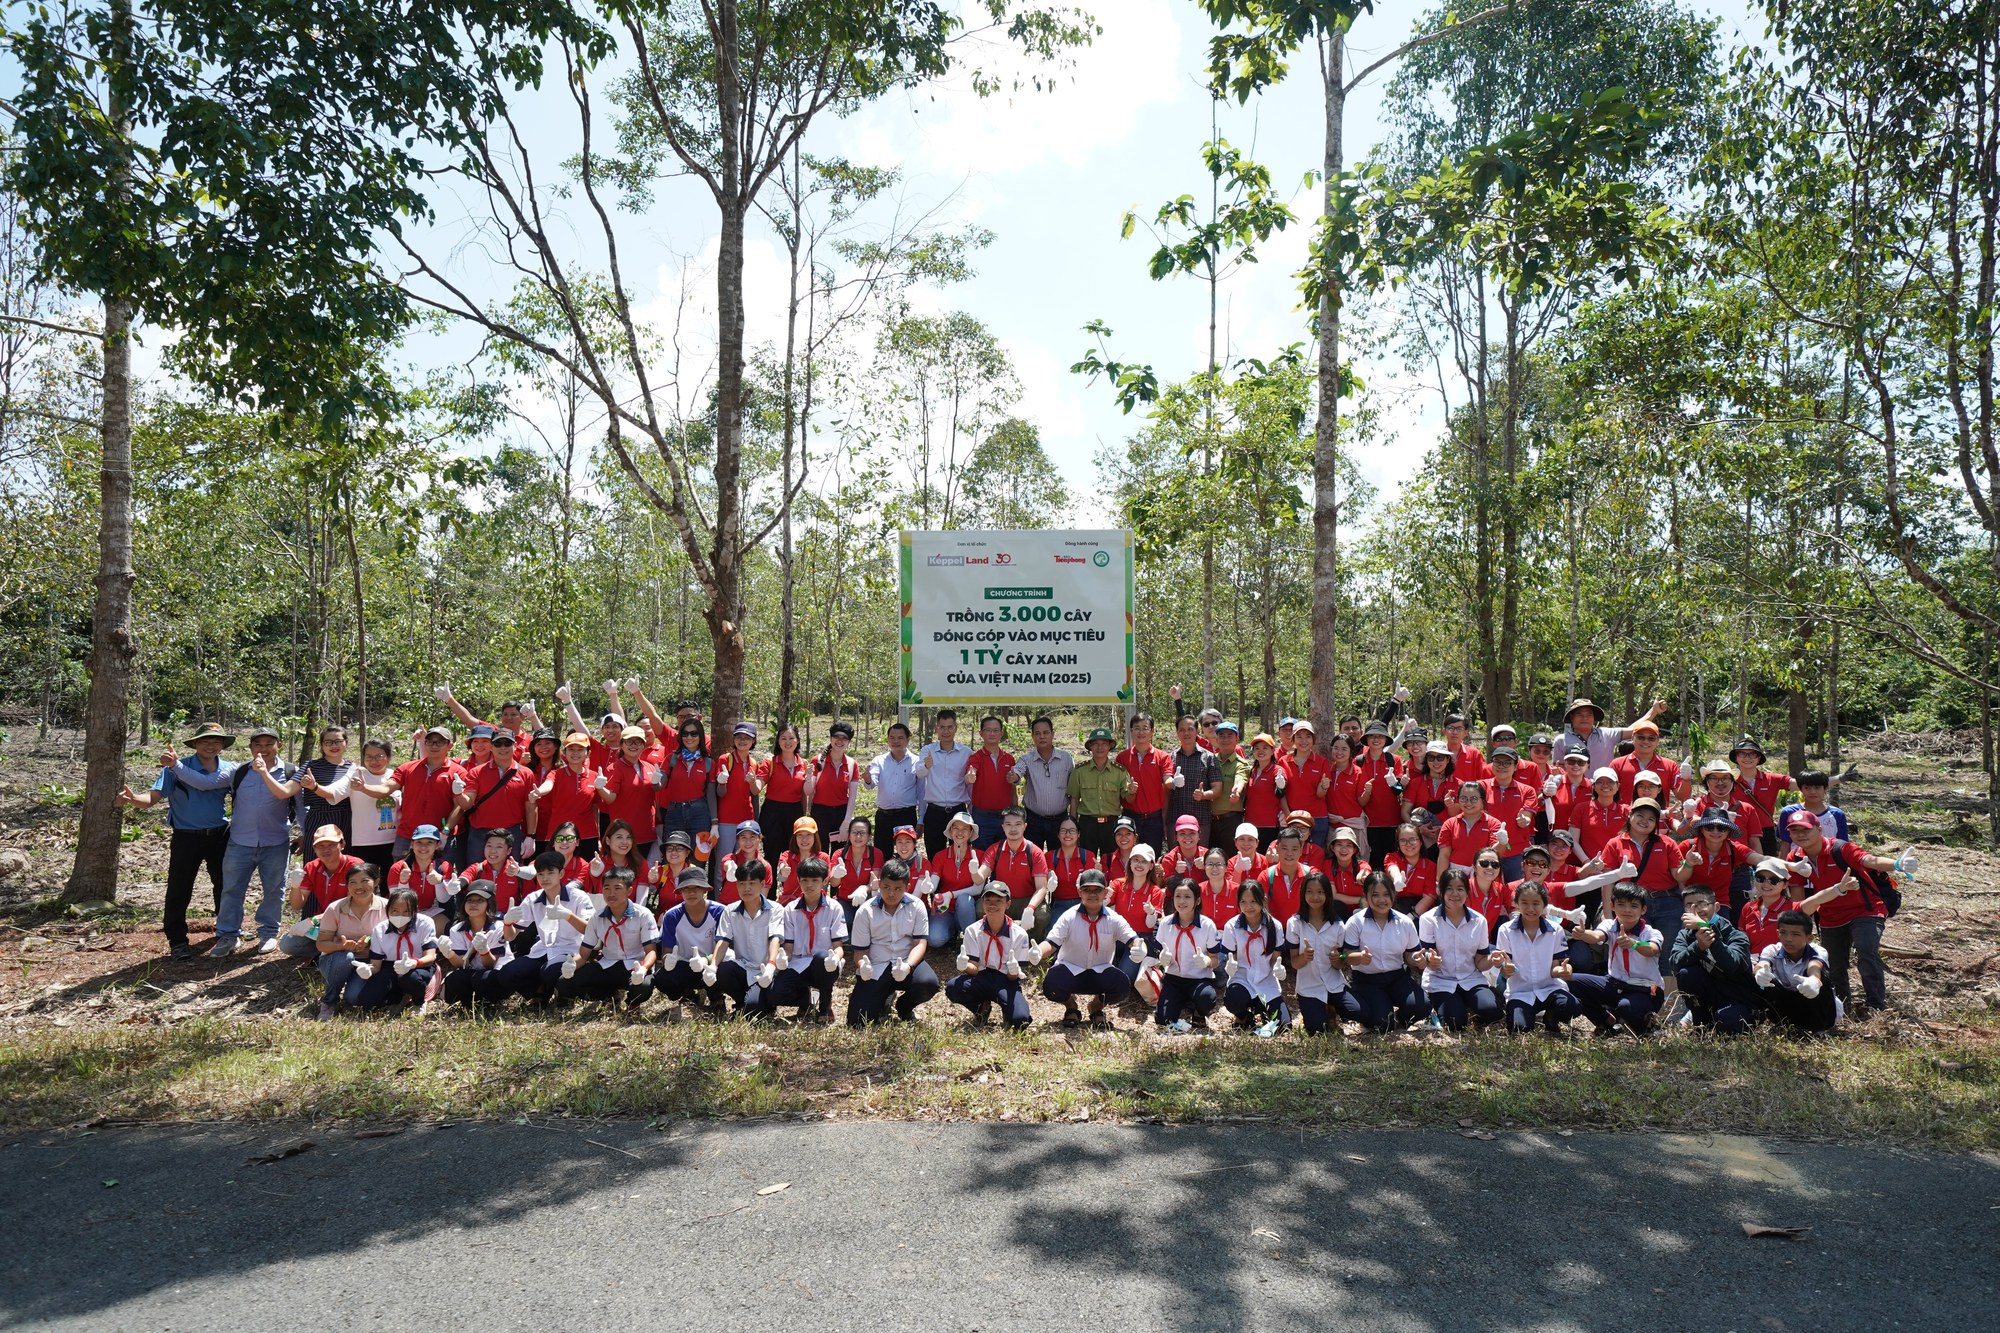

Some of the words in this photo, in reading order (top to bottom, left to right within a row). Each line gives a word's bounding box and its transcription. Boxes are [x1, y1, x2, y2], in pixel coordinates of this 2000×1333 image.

[996, 554, 1011, 564] 30
[946, 608, 994, 622] TRỒNG
[998, 606, 1062, 622] 3.000
[1064, 609, 1092, 622] CÂY
[933, 629, 974, 642] ĐÓNG
[976, 629, 1005, 642] GÓP
[1008, 629, 1038, 642] VÀO
[1040, 631, 1071, 645] MỤC
[1074, 629, 1105, 642] TIÊU
[960, 649, 969, 665] 1
[974, 643, 1003, 665] TỶ
[1006, 652, 1034, 665] CÂY
[1036, 654, 1077, 665] XANH
[947, 670, 976, 684] CỦA
[978, 671, 1010, 687] VIỆT
[1013, 673, 1046, 684] NAM
[1048, 672, 1092, 685] (2025)
